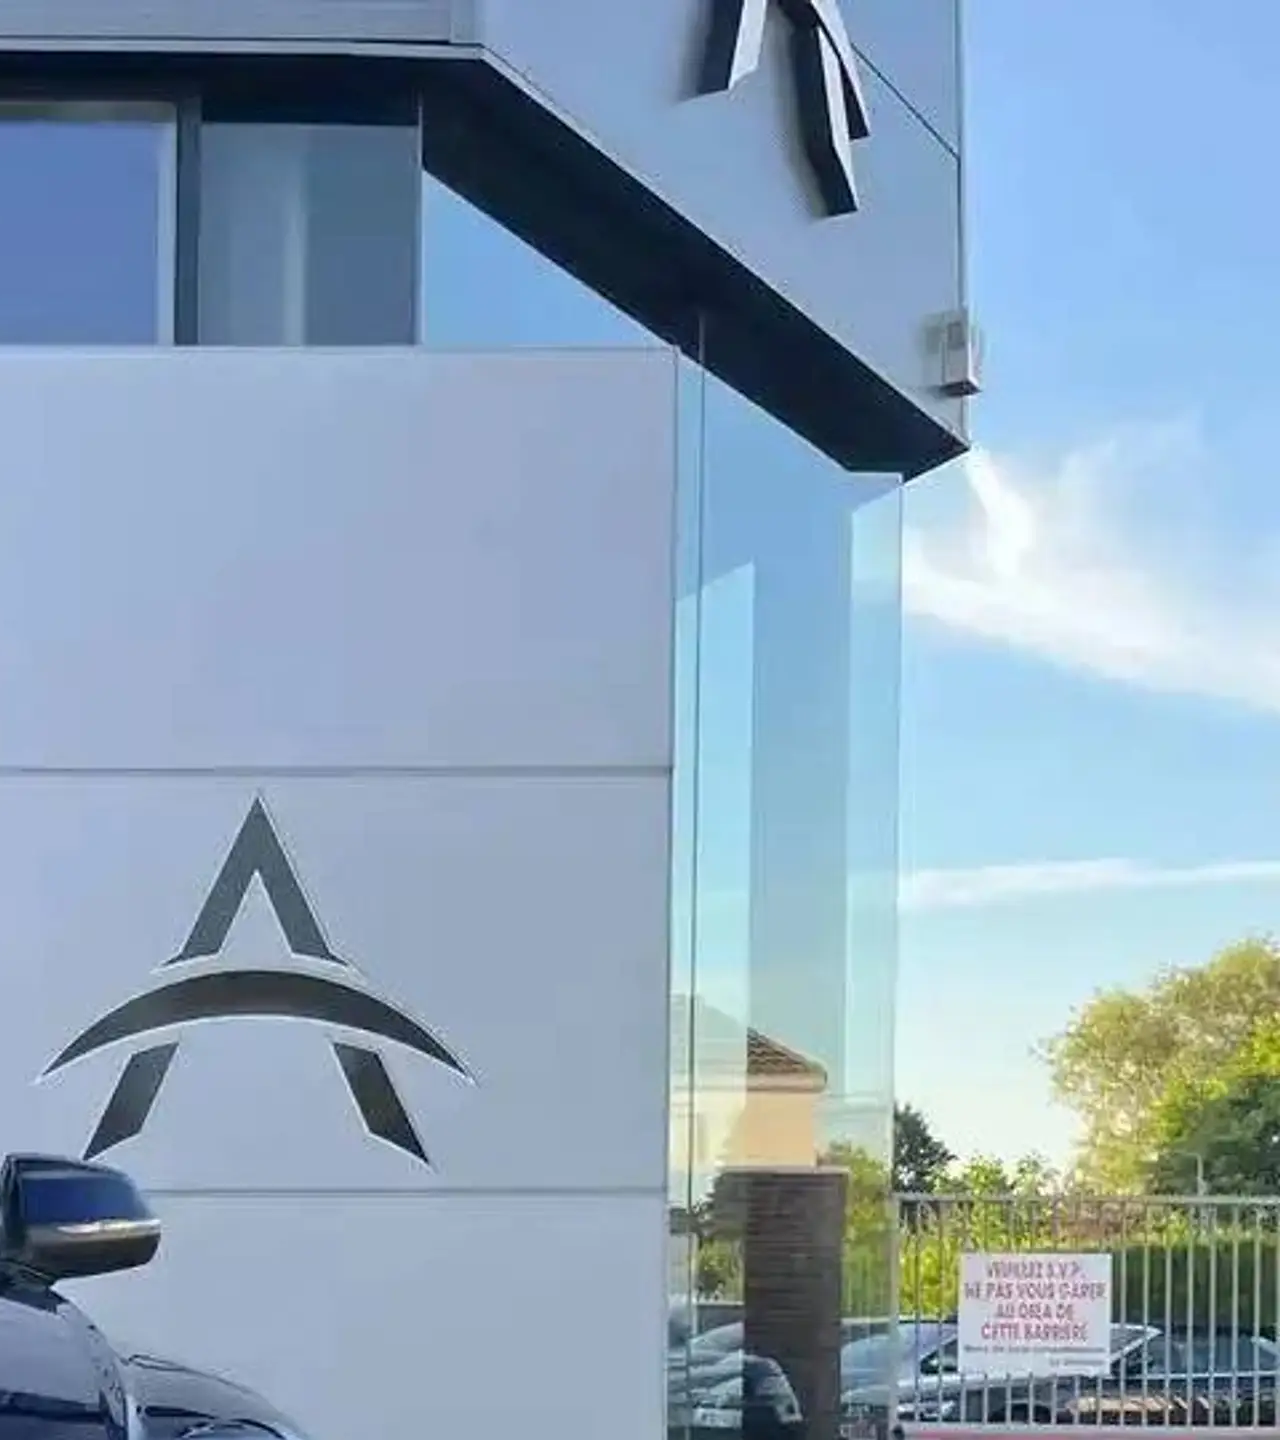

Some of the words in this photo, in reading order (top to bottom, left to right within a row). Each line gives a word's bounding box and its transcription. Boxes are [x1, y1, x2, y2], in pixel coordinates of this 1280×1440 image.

[986, 1282, 1013, 1299] PAS
[1016, 1282, 1054, 1299] VOUS
[996, 1303, 1015, 1319] AU
